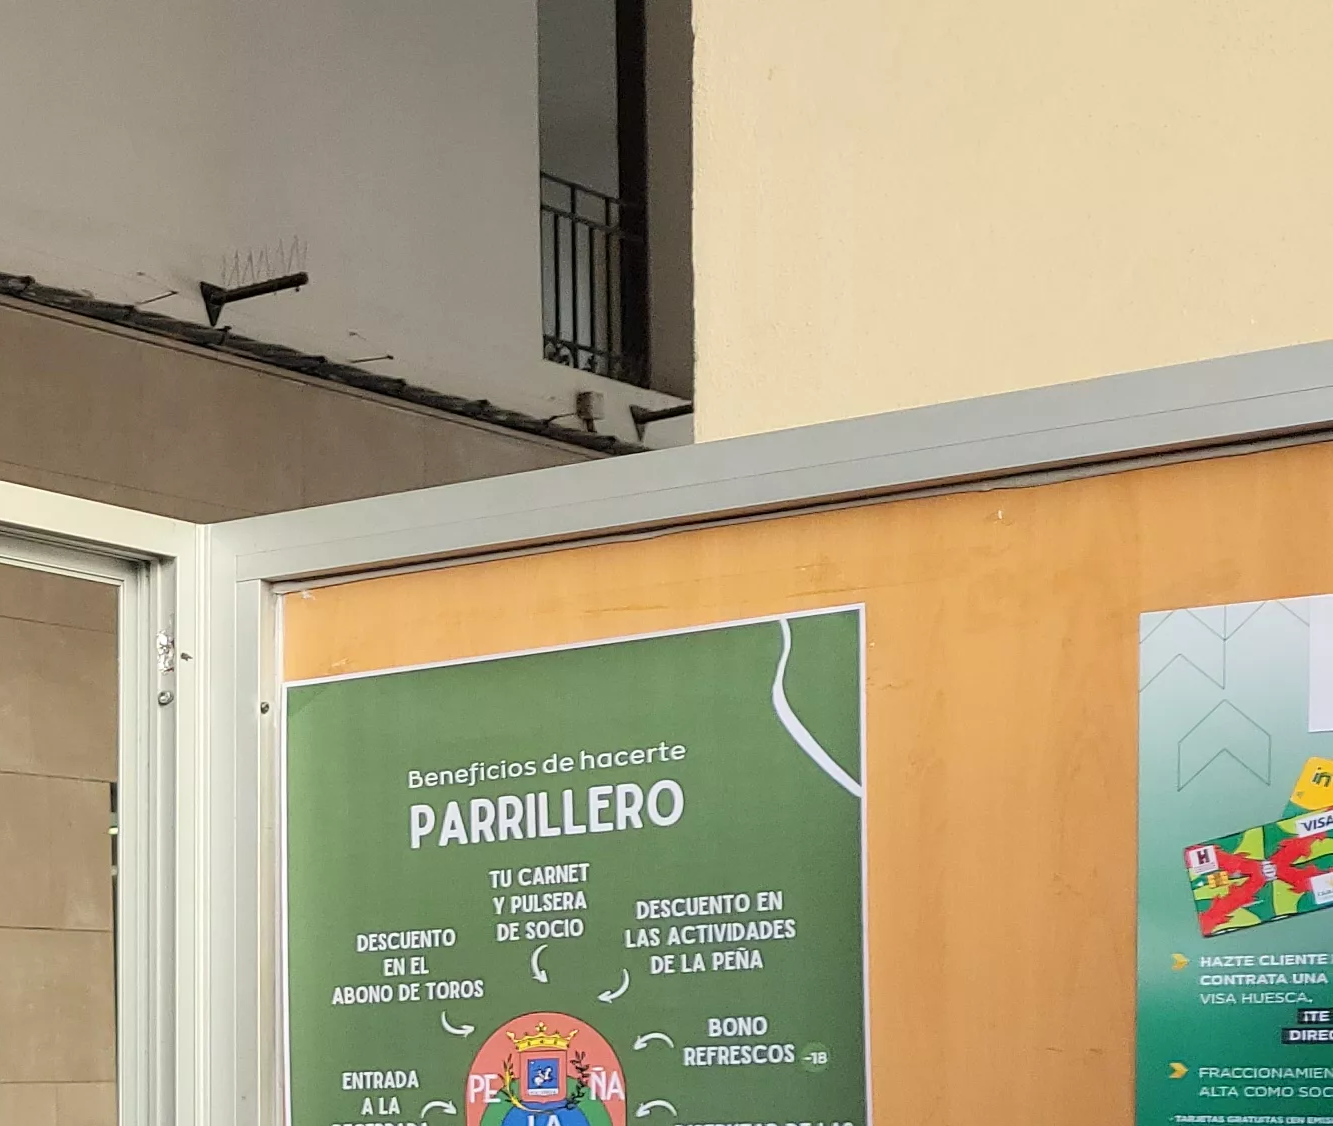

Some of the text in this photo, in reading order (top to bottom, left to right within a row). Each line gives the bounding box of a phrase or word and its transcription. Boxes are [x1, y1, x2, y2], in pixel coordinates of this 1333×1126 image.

[408, 741, 686, 789] Beneficios de hacerte
[408, 778, 684, 849] PARRILLERO
[488, 862, 590, 889] TU CARNET
[492, 890, 587, 915] Y PULSERA
[635, 890, 783, 920] DESCUENTO EN
[356, 928, 456, 952] DESCUENTO
[496, 918, 584, 942] DE SOCIO
[625, 919, 796, 948] LAS ACTIVIDADES
[383, 956, 430, 977] EN EL
[650, 947, 764, 975] DE LA PEÑA
[1201, 956, 1254, 967] HAZTE
[1259, 954, 1328, 965] CLIENTE
[1200, 973, 1328, 985] CONTRATA UNA
[331, 979, 484, 1005] ABONO DE TOROS
[1200, 993, 1236, 1004] VISA
[708, 1016, 768, 1037] BONO
[683, 1043, 828, 1066] REFRESCOS -18
[342, 1070, 419, 1090] ENTRADA
[1199, 1087, 1238, 1097] ALTA
[1244, 1087, 1294, 1097] COMO
[361, 1096, 401, 1115] A LA
[1175, 1115, 1224, 1123] TARJETAS
